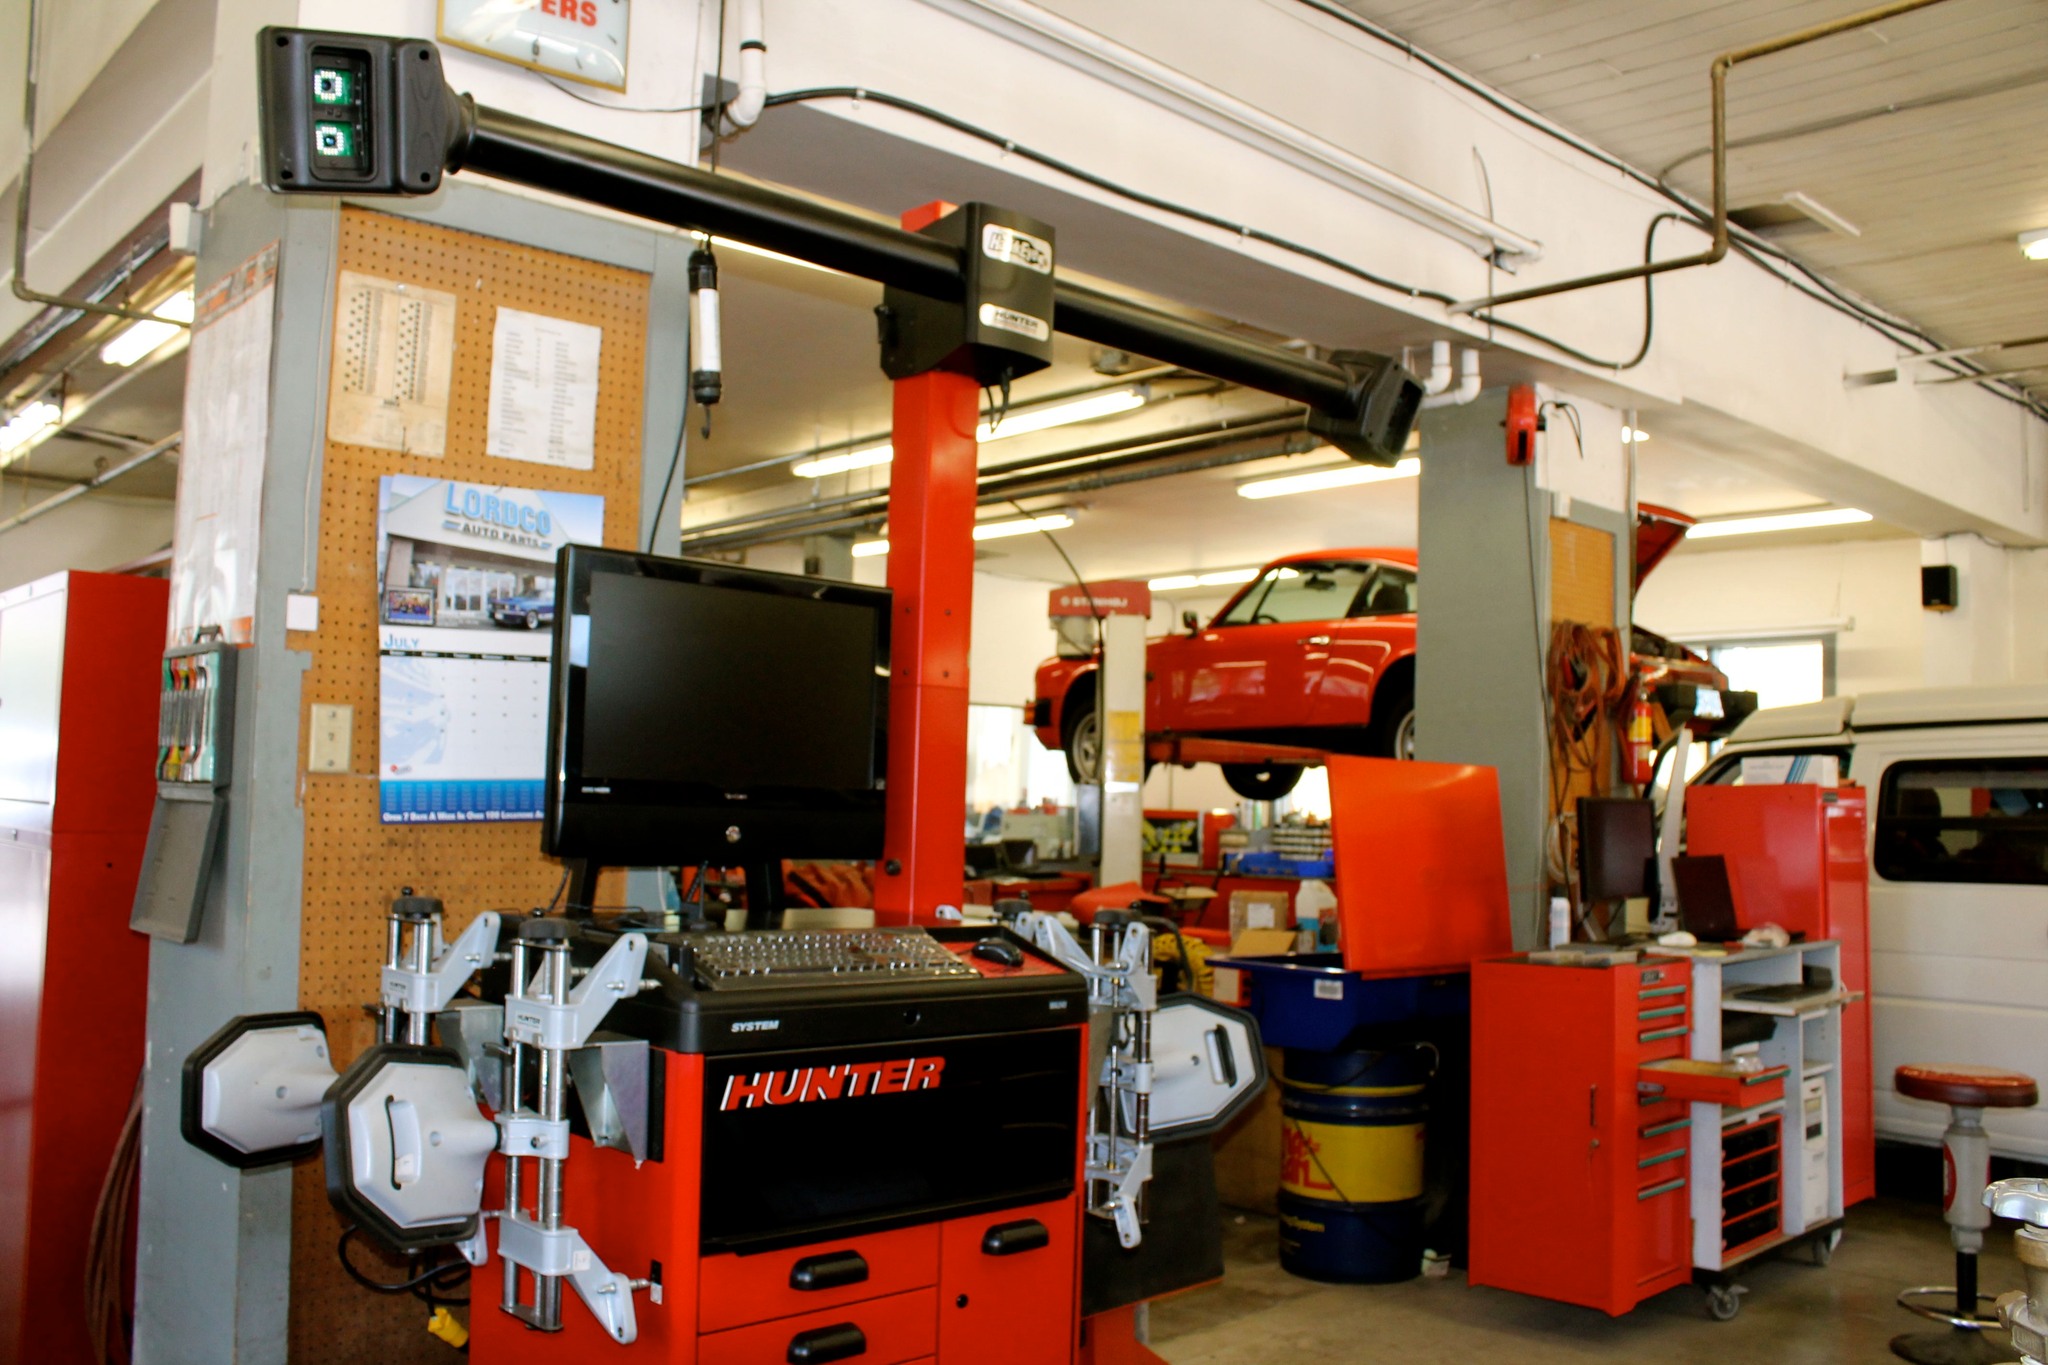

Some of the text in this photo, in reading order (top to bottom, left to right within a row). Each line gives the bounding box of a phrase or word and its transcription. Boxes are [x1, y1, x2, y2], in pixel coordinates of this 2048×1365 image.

[995, 310, 1039, 329] HUNTER
[445, 481, 552, 537] LORDCO
[462, 522, 540, 548] AUTO PARTS
[731, 1020, 780, 1033] SYSTEM
[720, 1056, 946, 1111] HUNTER
